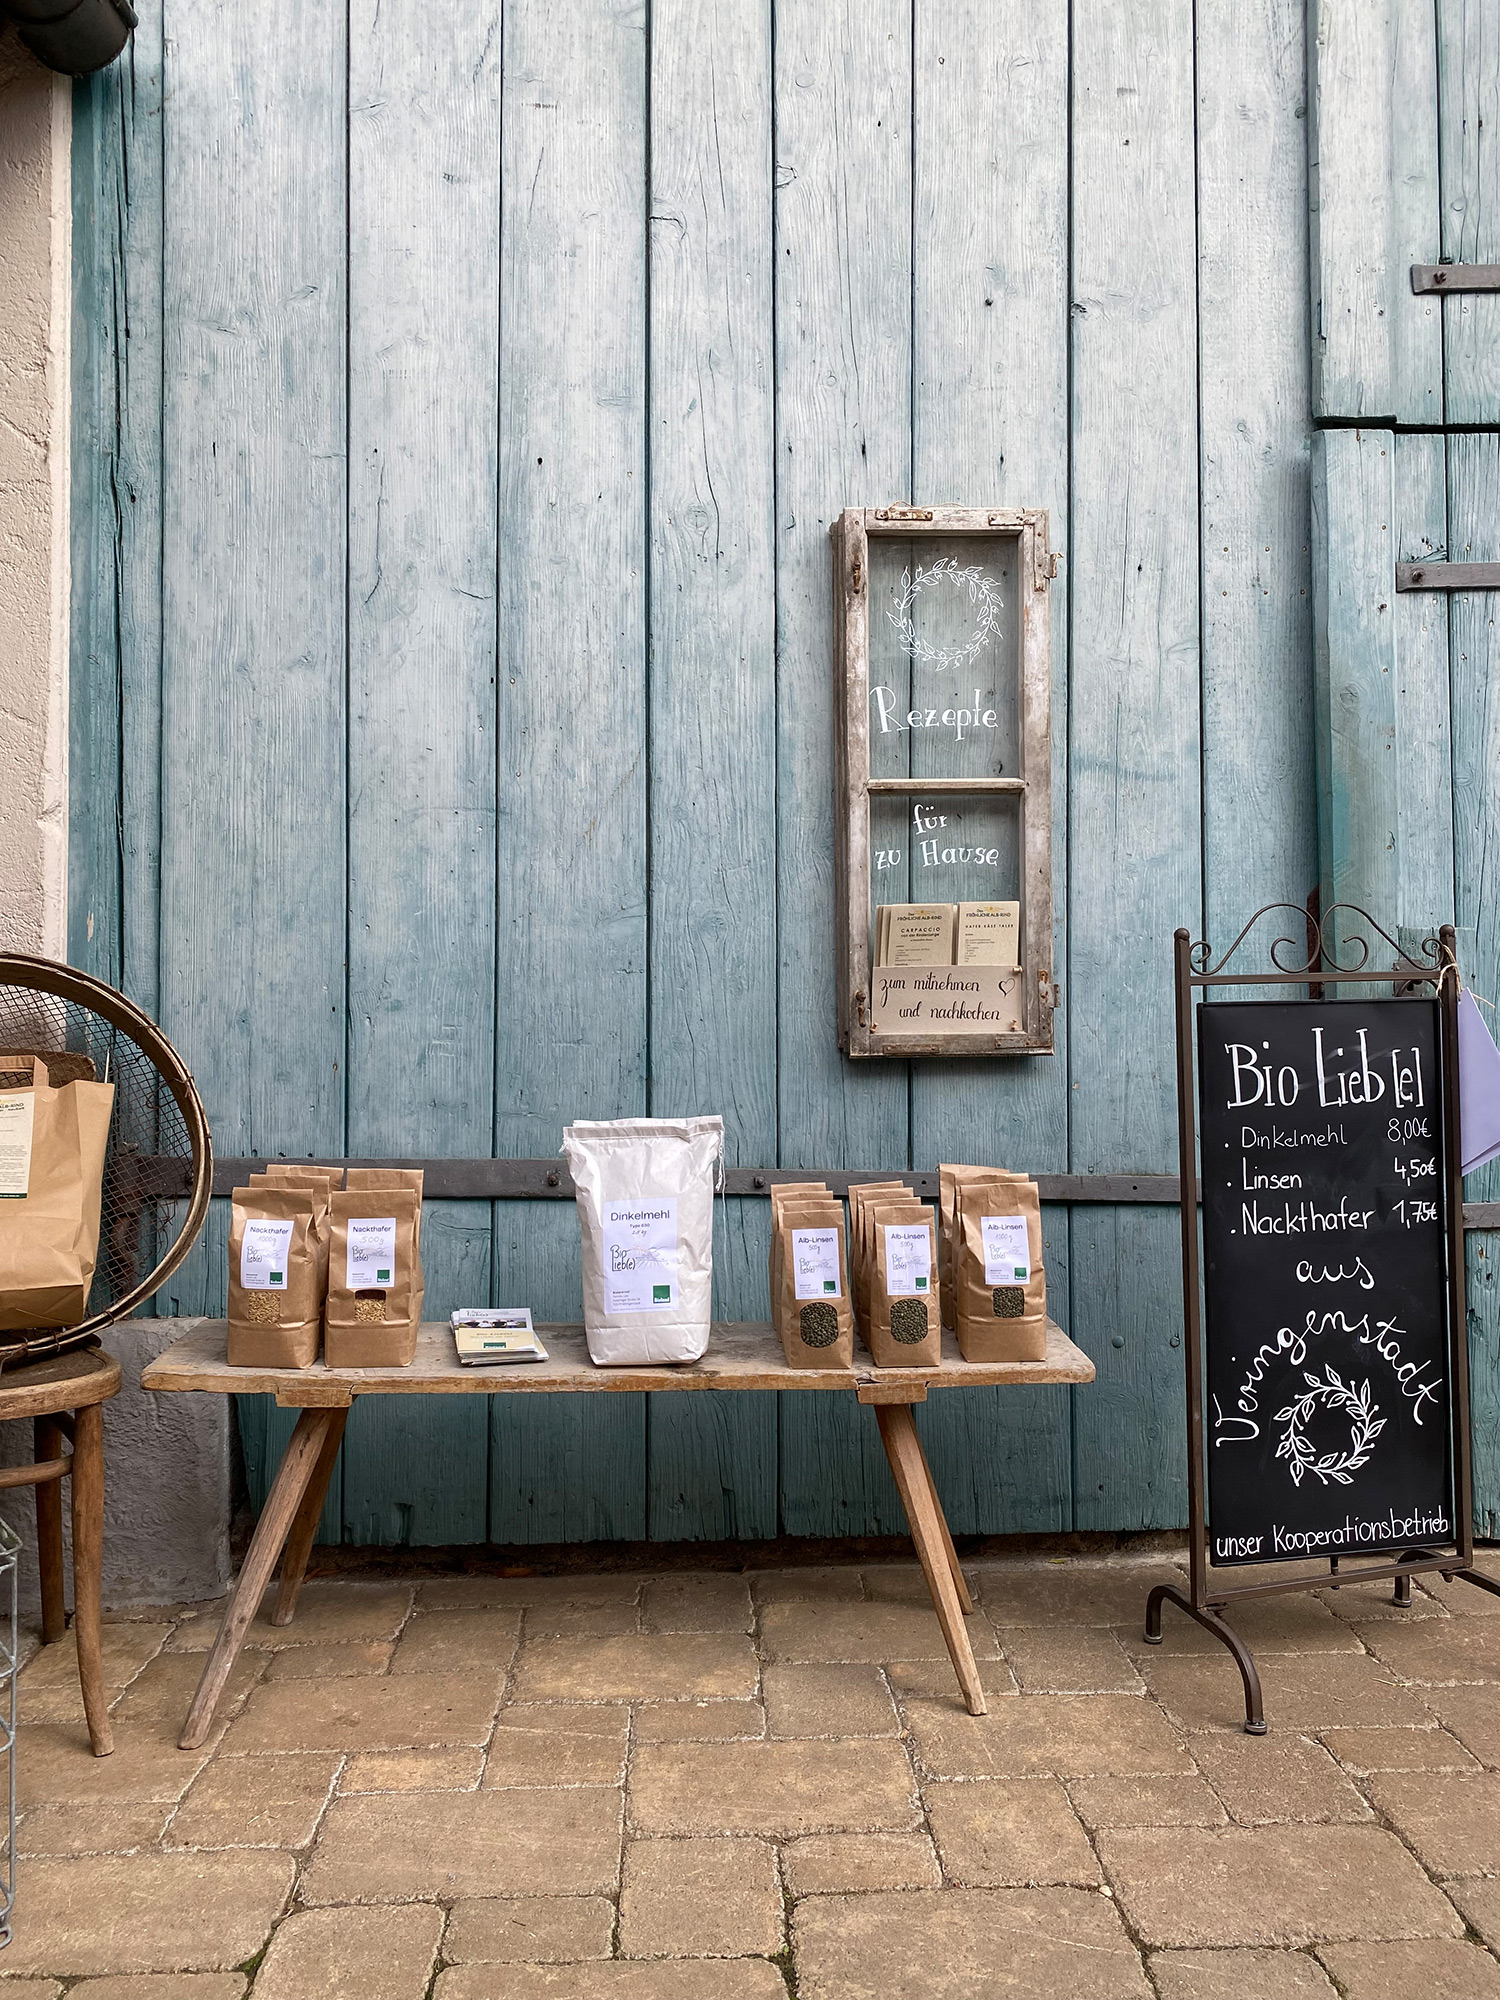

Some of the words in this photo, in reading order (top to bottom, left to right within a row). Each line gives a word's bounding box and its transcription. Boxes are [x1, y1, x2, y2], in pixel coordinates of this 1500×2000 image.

[870, 685, 999, 742] Rezepte
[913, 804, 948, 835] für
[875, 849, 901, 870] zu
[919, 838, 999, 868] Hause
[879, 978, 906, 1008] zum
[913, 971, 980, 992] mitnehmen
[899, 1001, 922, 1018] und
[930, 1001, 1001, 1020] nachkochen
[1225, 1041, 1299, 1109] Bio
[1241, 1124, 1348, 1149] Dinkelmehl
[1387, 1118, 1432, 1145] 8,00€
[1242, 1157, 1303, 1190] Linsen
[1394, 1157, 1437, 1186] 4,50€
[250, 1226, 289, 1234] Nackthafer
[610, 1210, 670, 1221] Dinkelmehl
[1242, 1195, 1377, 1235] Nackthafer
[1392, 1200, 1438, 1229] 1,75€
[359, 1236, 385, 1246] 500g
[610, 1244, 627, 1259] Bio
[1296, 1256, 1375, 1290] aus
[1213, 1310, 1443, 1447] Veringenstadt
[1216, 1535, 1265, 1557] unser
[1272, 1505, 1449, 1553] Kooperationsbetrieb
